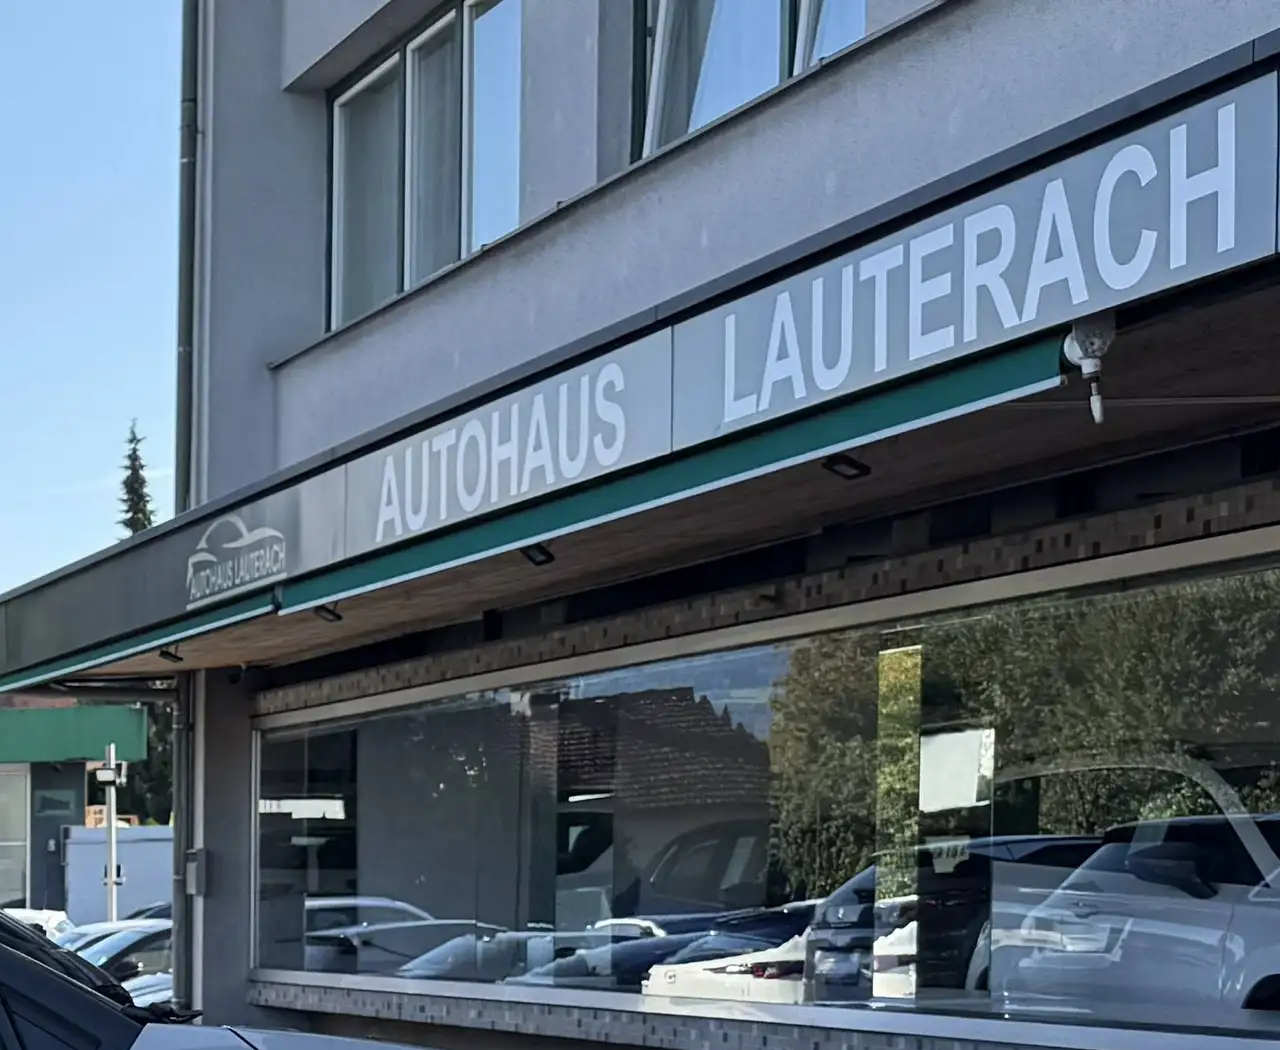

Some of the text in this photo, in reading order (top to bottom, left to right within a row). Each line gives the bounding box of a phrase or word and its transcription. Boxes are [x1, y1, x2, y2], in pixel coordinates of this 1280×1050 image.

[375, 102, 1236, 542] AUTOHAUS LAUTERACH
[189, 540, 286, 600] AUTOHAUS LAUTERACH
